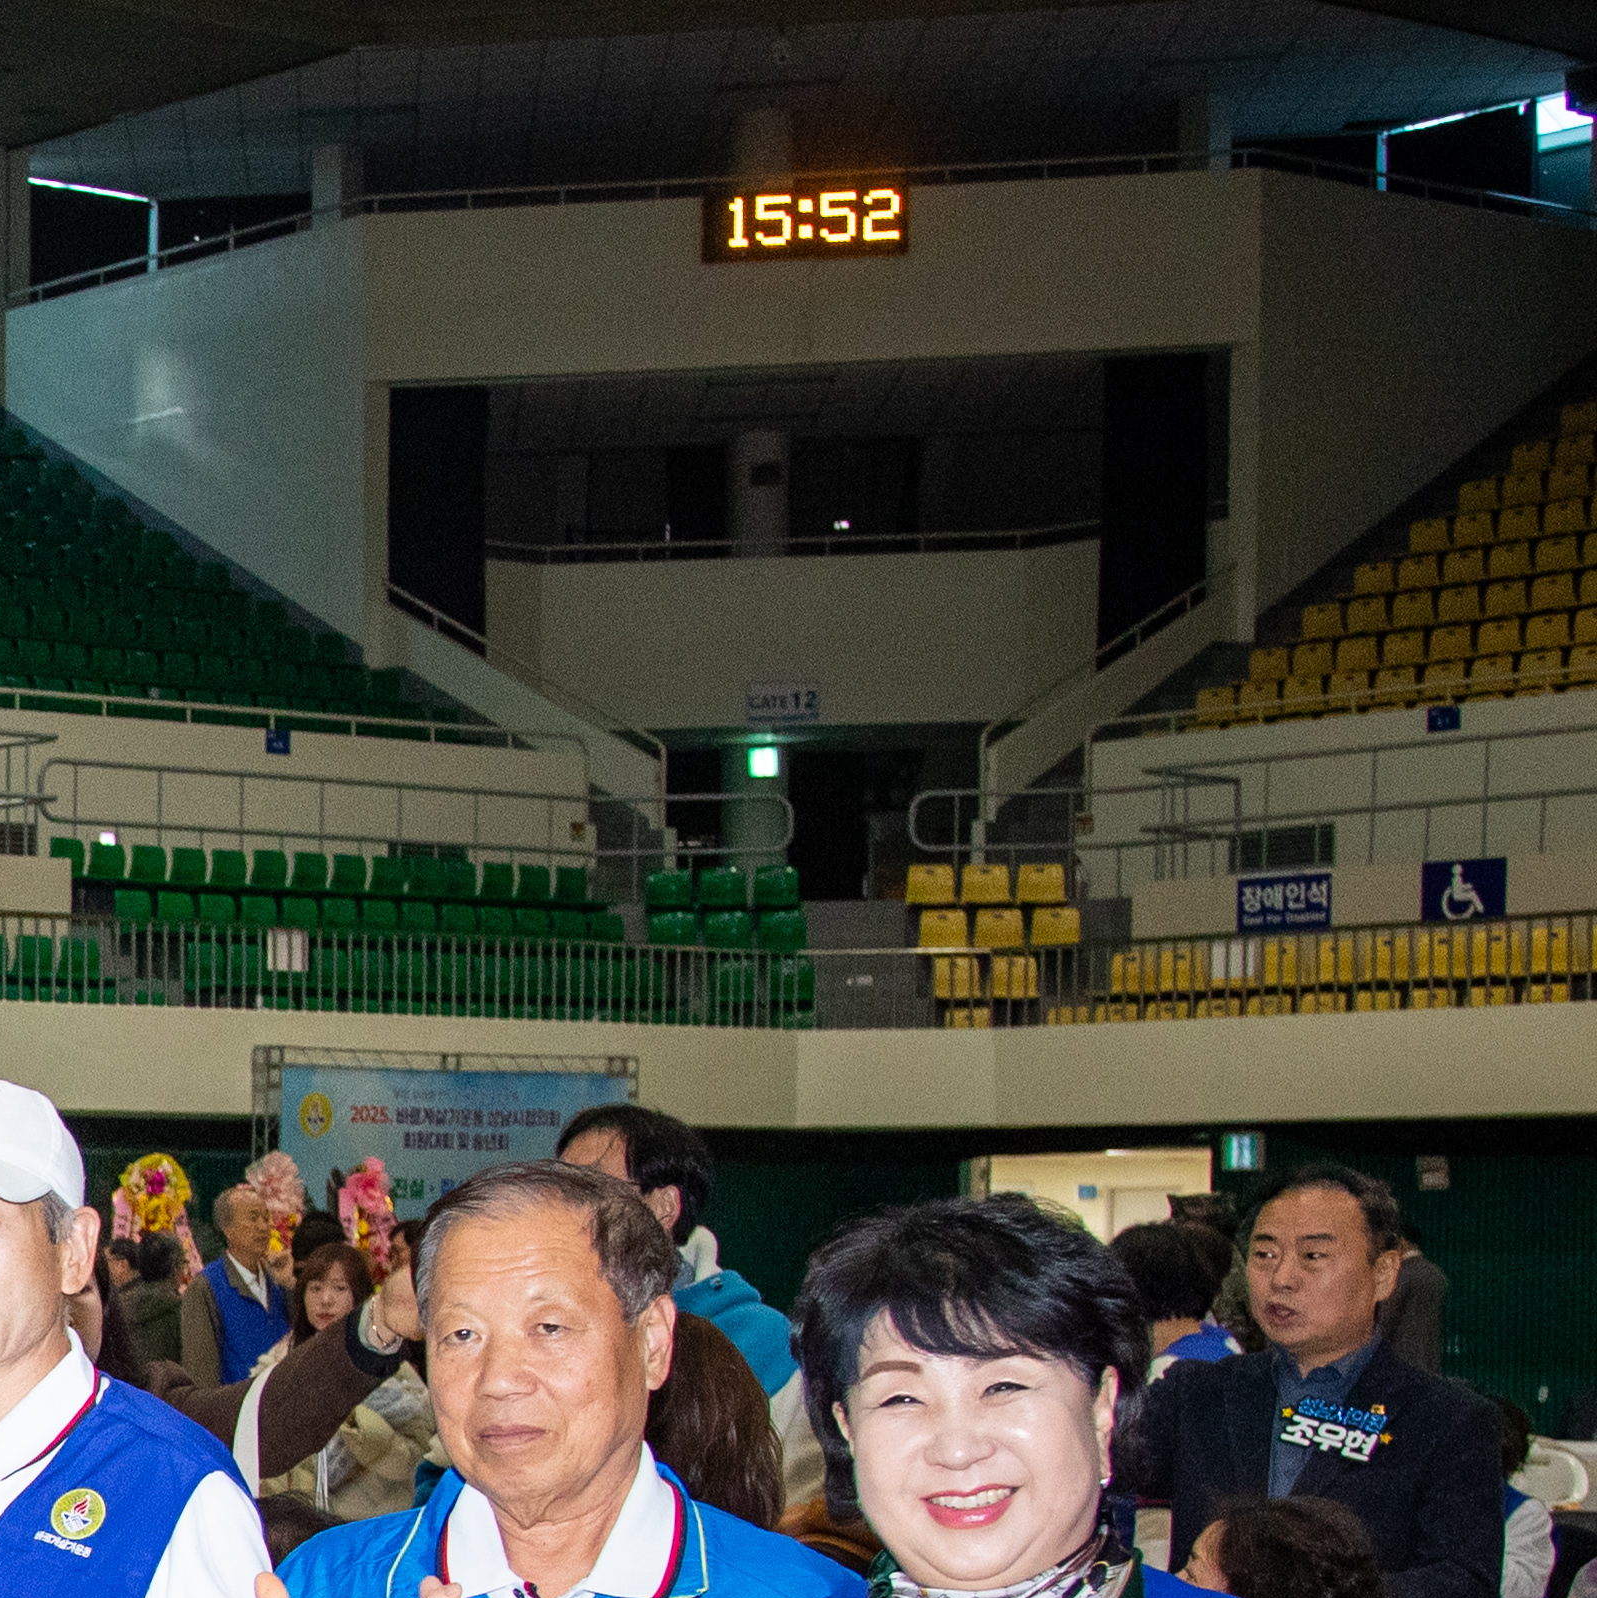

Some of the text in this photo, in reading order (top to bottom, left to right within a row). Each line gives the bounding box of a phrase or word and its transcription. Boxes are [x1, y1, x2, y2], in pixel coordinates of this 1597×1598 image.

[729, 189, 900, 247] 15:52
[1242, 881, 1327, 914] 장애인석
[351, 1105, 561, 1127] 2025. 바르게살기운동 성남시협의회
[404, 1130, 455, 1149] 회원대회
[472, 1132, 510, 1150] 송년회
[1280, 1414, 1380, 1462] 조우현
